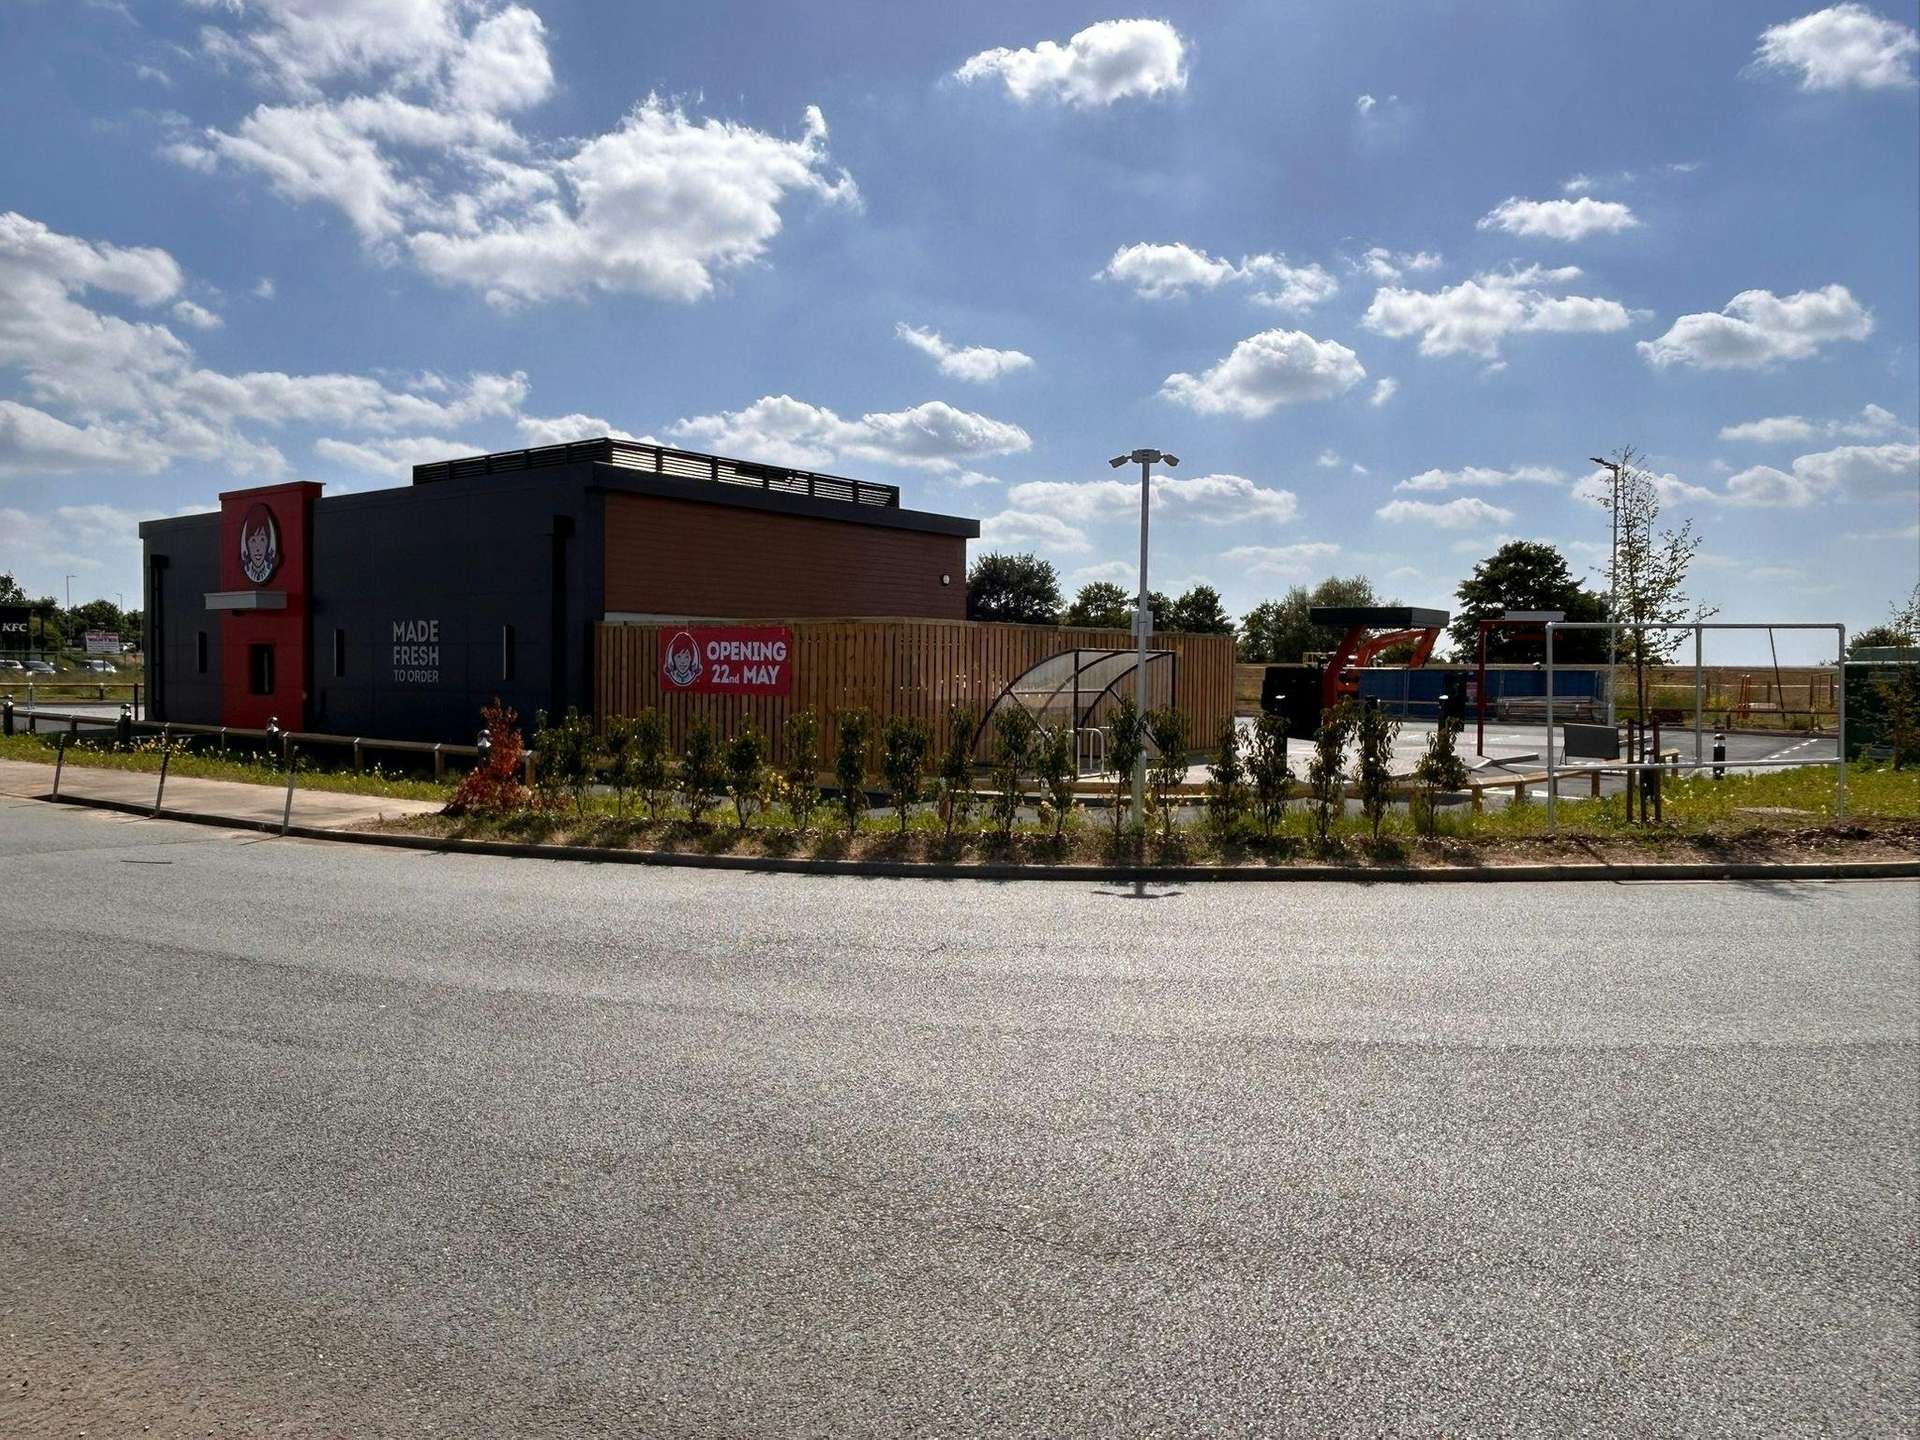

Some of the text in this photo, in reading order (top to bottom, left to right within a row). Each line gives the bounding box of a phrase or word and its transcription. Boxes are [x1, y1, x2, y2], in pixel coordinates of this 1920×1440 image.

[2, 623, 28, 632] KFC
[393, 620, 439, 642] MADE
[393, 646, 439, 666] FRESH
[706, 641, 787, 661] OPENING
[393, 669, 439, 682] TO ORDER
[712, 664, 780, 685] 22nd MAY
